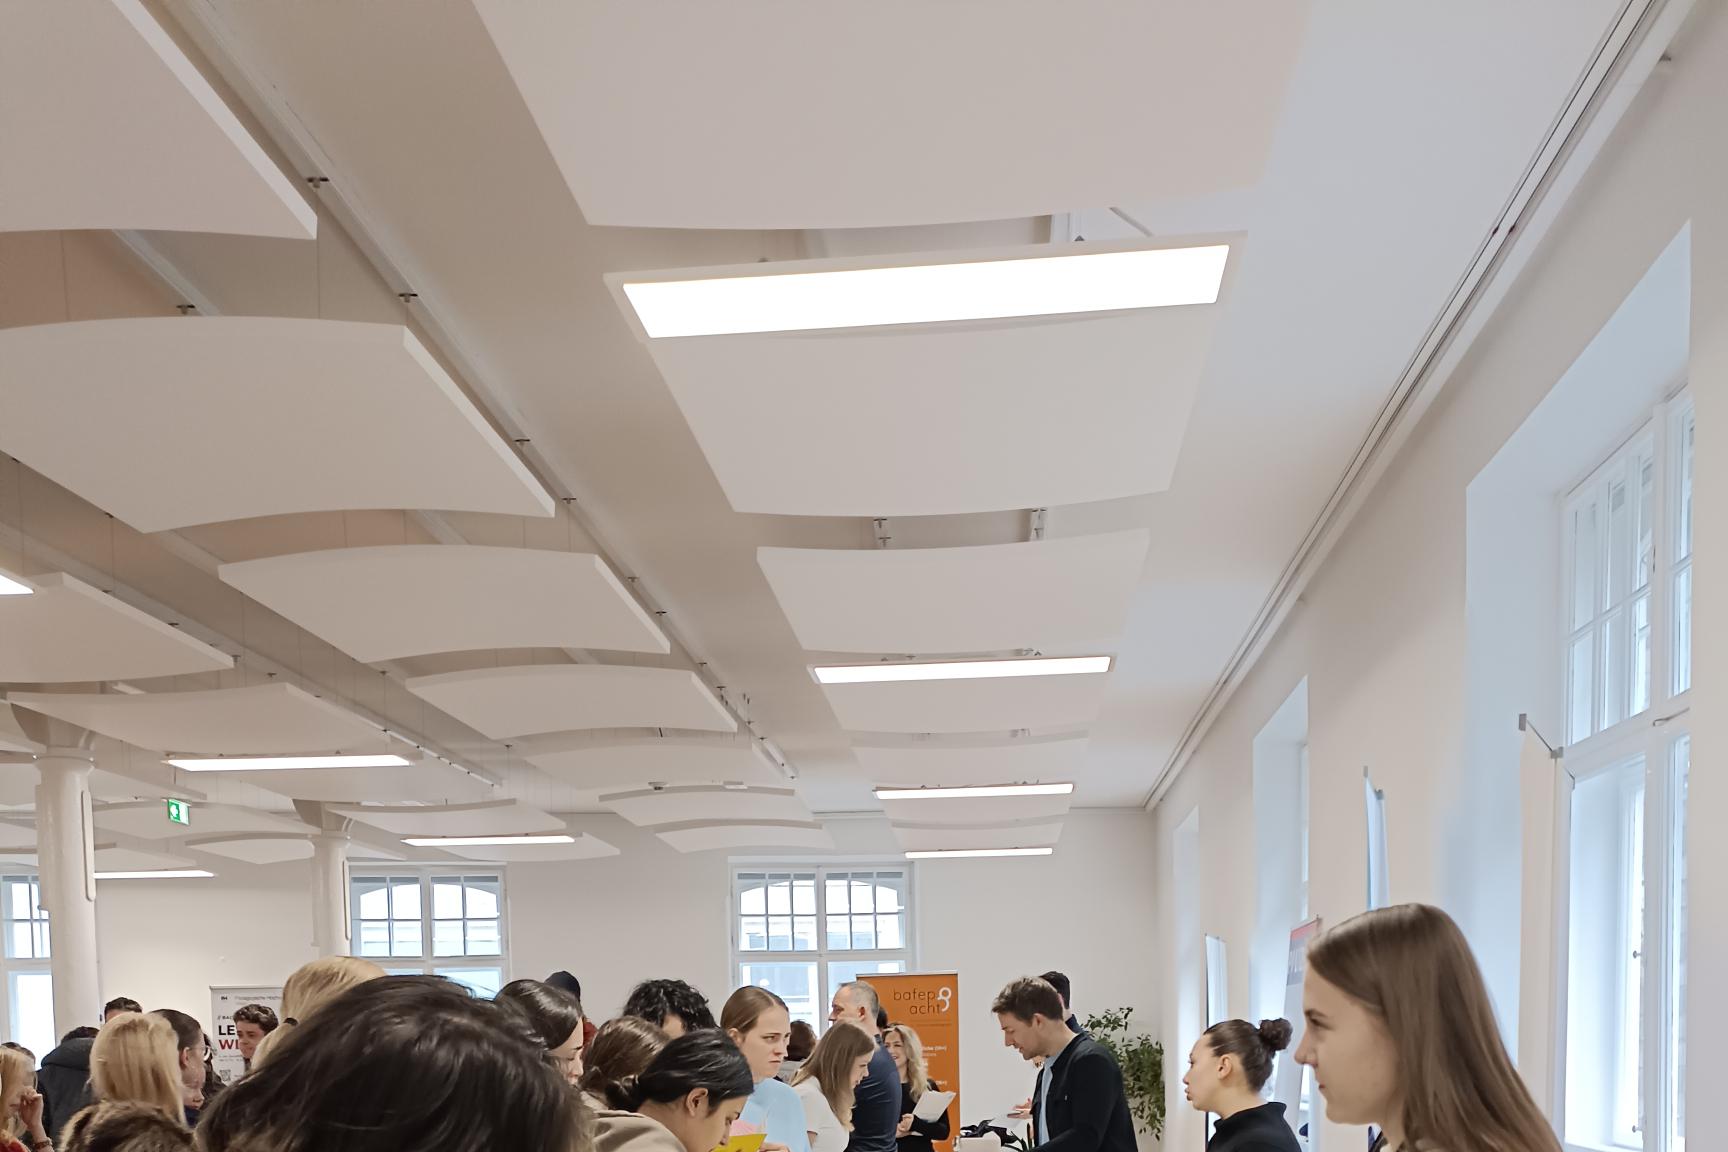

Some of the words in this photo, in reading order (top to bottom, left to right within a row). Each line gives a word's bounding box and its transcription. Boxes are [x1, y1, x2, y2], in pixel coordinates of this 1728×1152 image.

[894, 988, 935, 1002] bafep
[910, 1001, 940, 1014] acht
[218, 1025, 236, 1036] LE
[218, 1040, 238, 1050] WI
